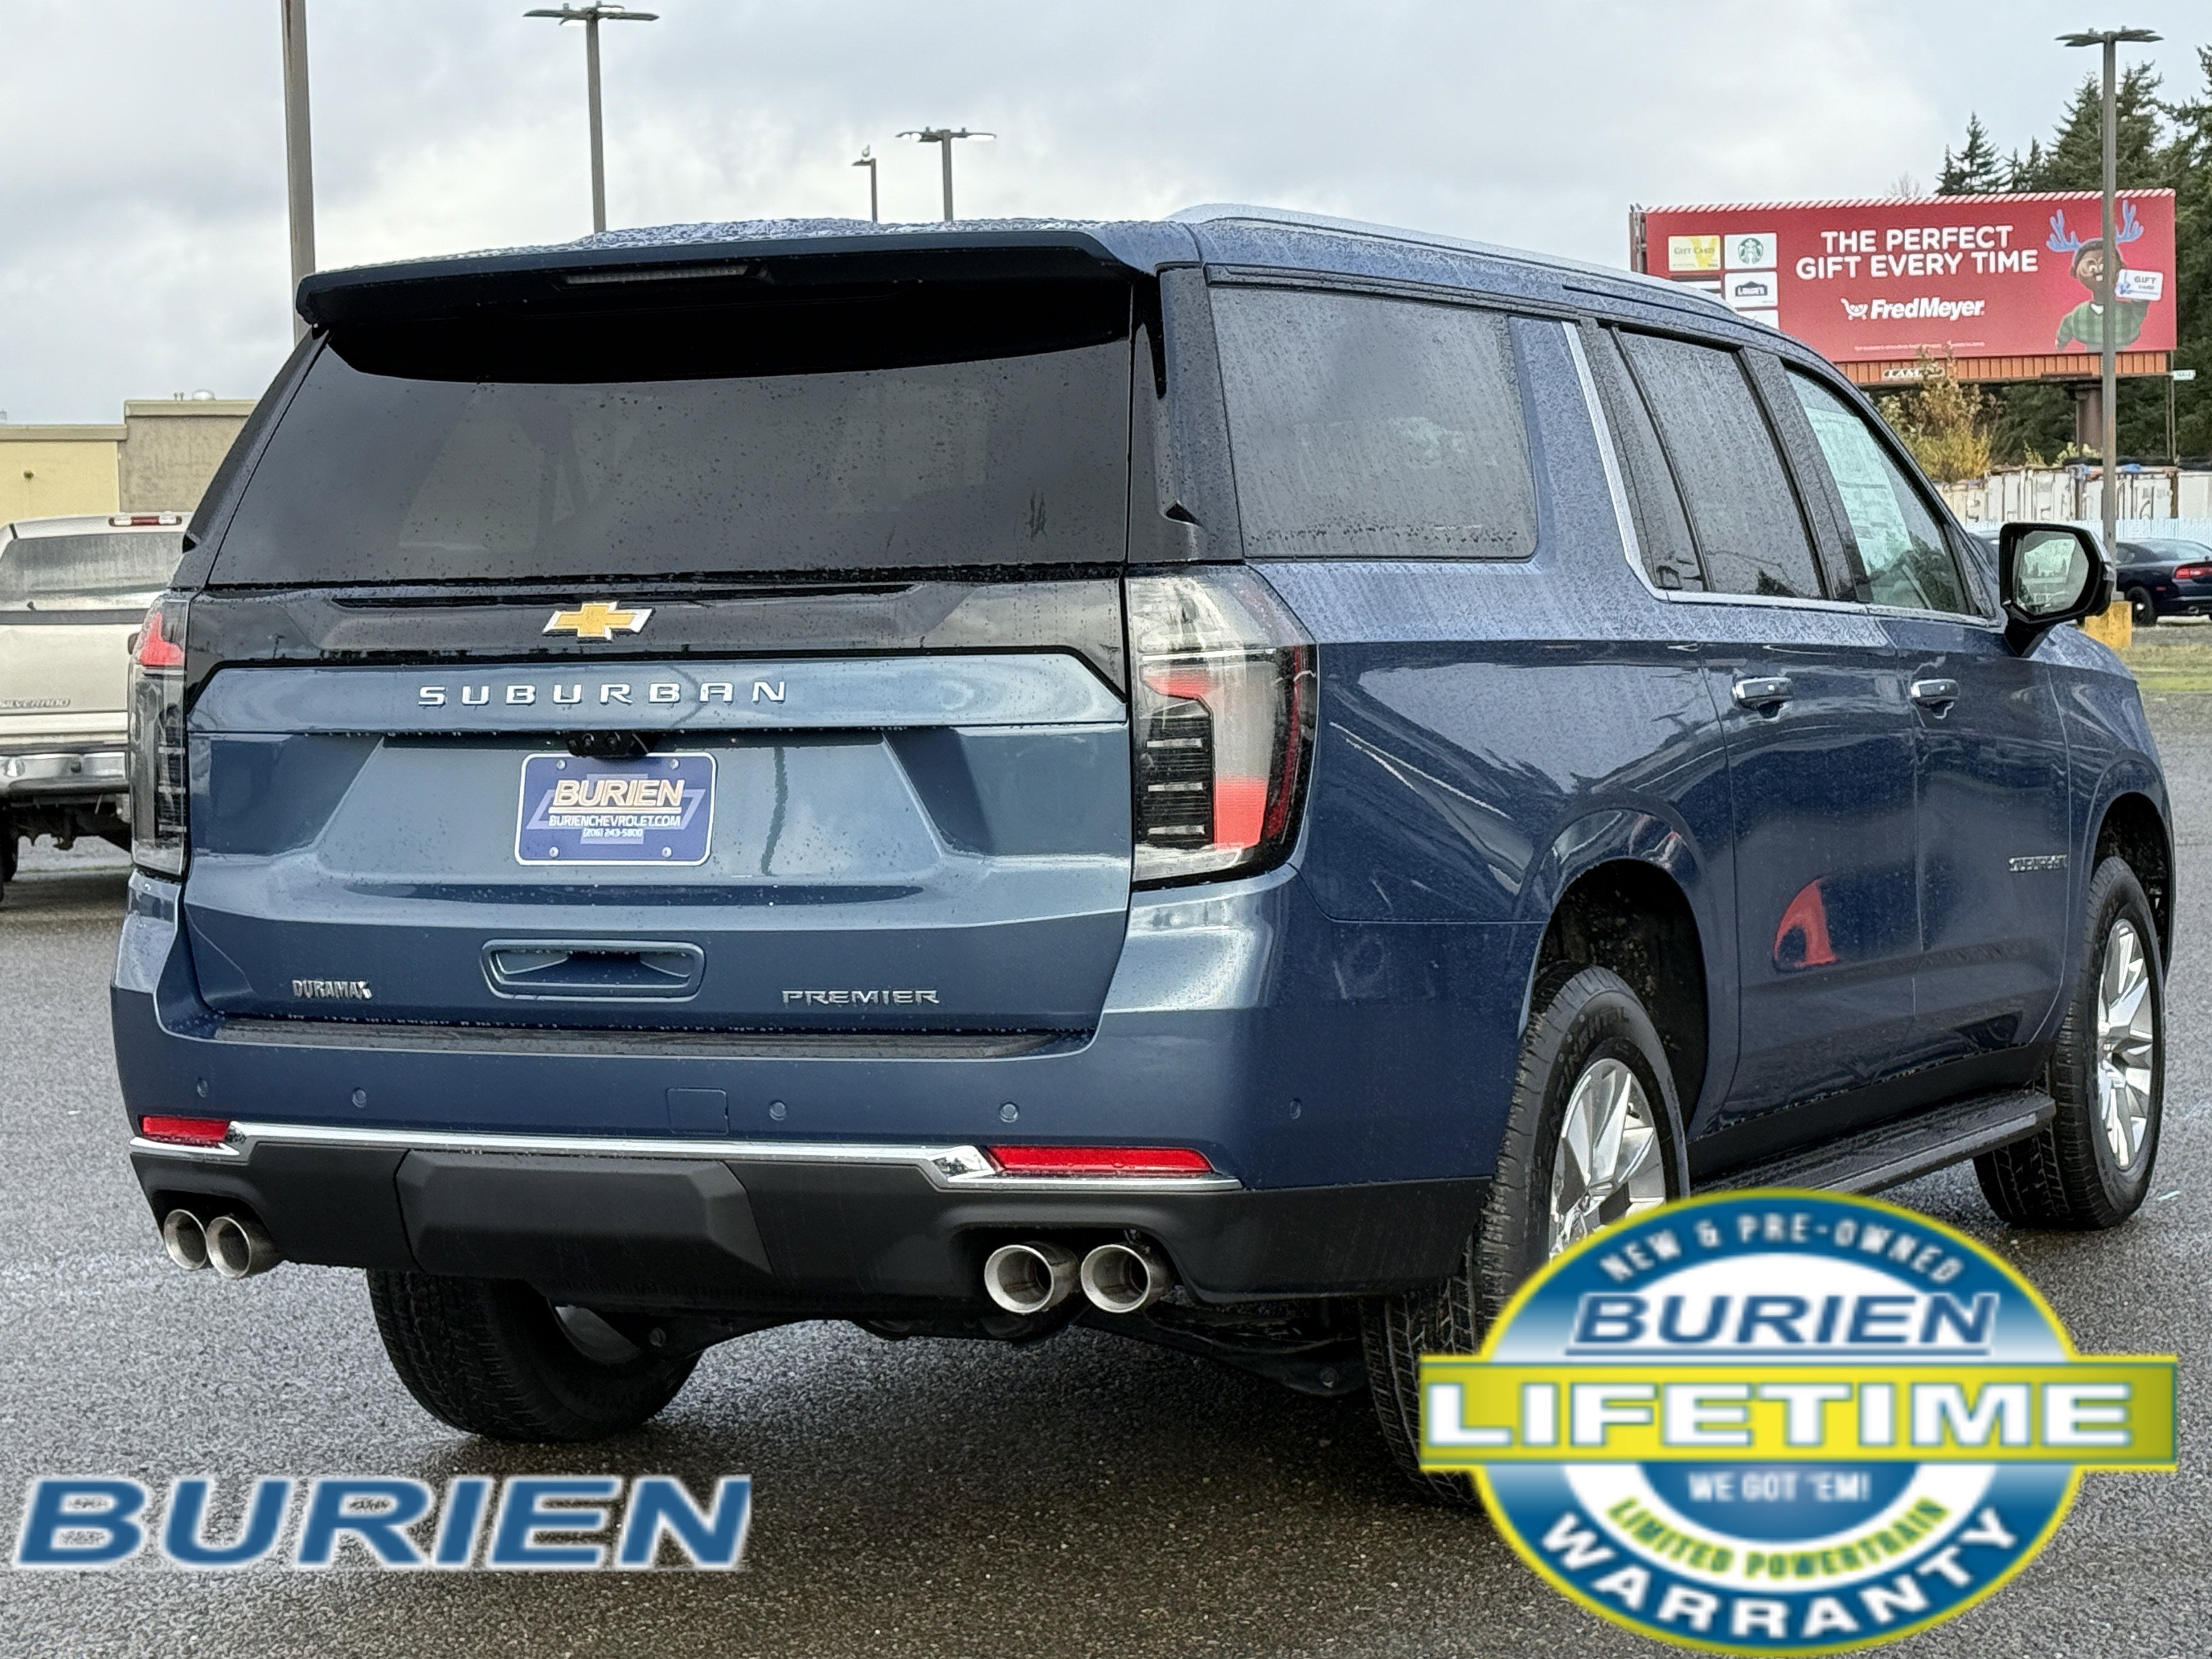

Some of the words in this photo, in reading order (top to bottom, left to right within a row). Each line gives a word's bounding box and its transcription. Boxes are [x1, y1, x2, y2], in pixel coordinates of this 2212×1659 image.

[1820, 229, 1877, 254] THE
[1886, 225, 2013, 252] PERFECT
[1796, 255, 1862, 280] GIFT
[1870, 252, 1963, 278] EVERY
[1971, 249, 2039, 274] TIME
[2134, 275, 2158, 285] GIFT
[417, 680, 786, 706] SUBURBAN
[552, 779, 685, 807] BURIEN
[292, 979, 373, 1000] DURAMAX
[781, 989, 940, 1005] PREMIER
